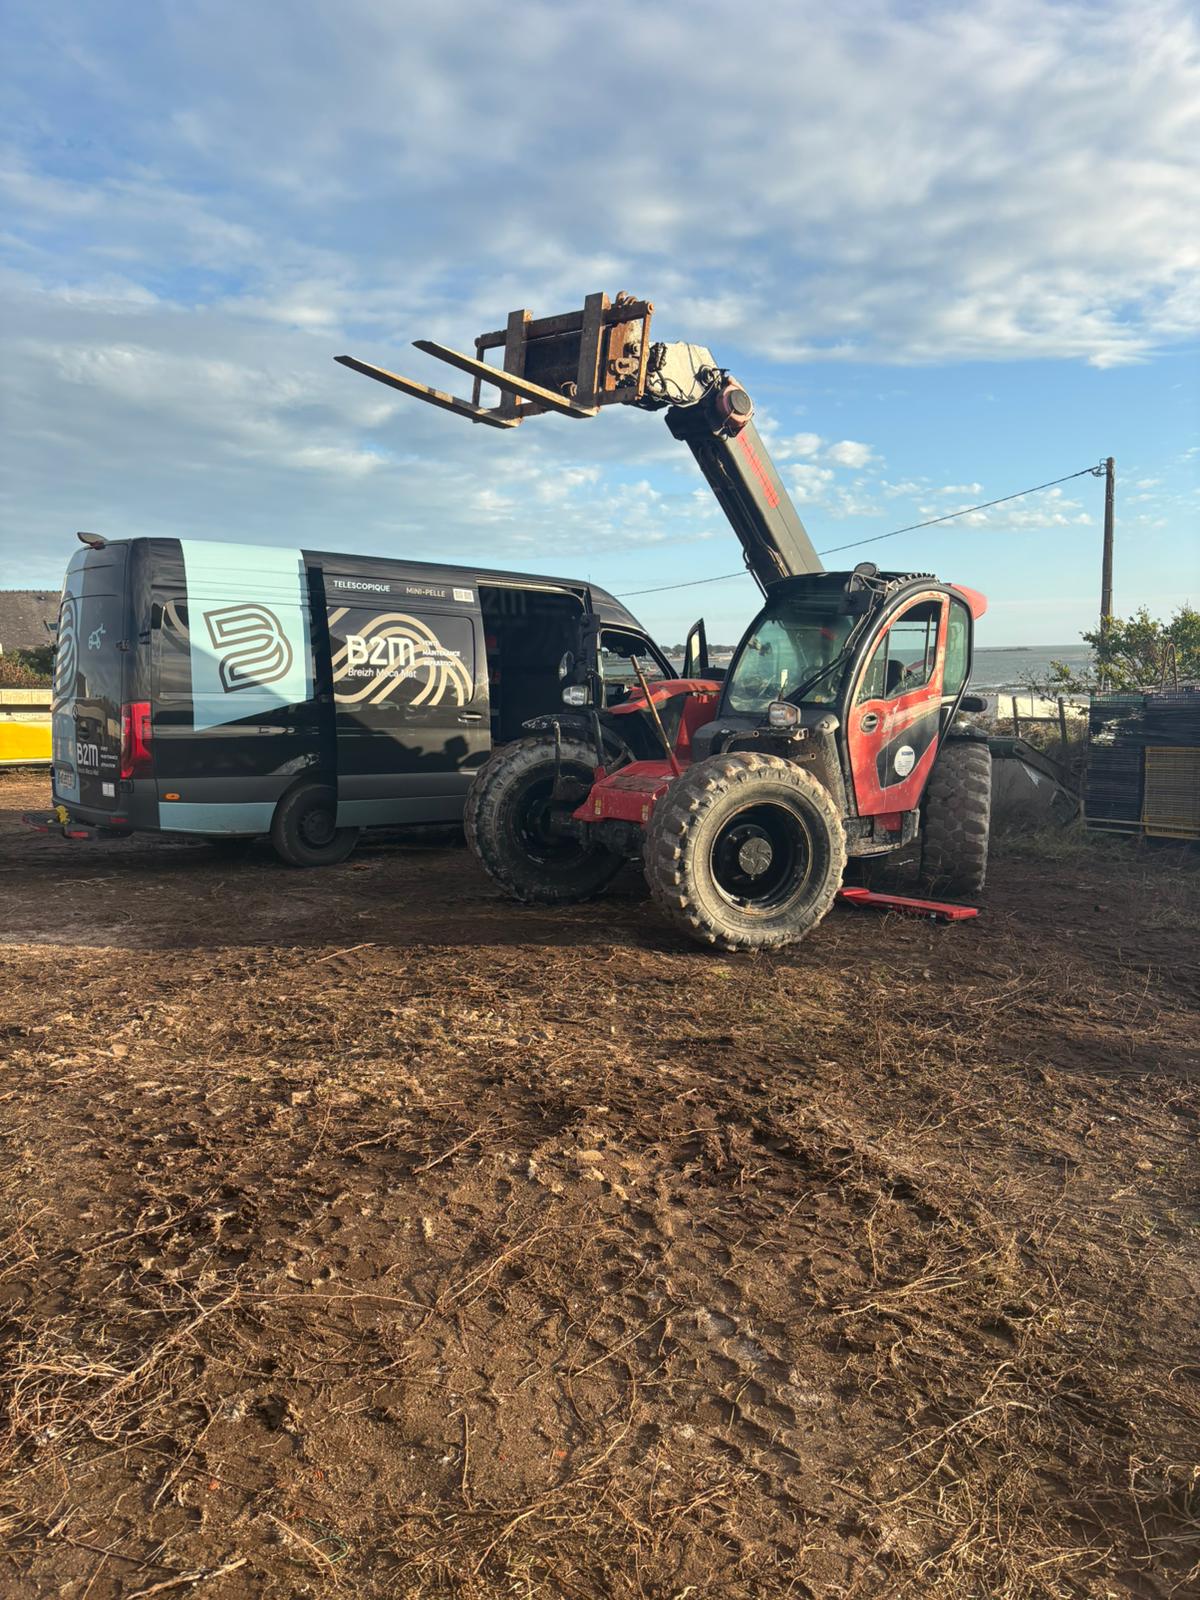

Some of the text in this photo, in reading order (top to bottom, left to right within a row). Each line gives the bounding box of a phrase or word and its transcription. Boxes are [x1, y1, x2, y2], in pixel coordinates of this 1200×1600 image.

[333, 580, 391, 592] TELESCOPIQUE
[345, 635, 417, 666] B2M
[348, 667, 374, 677] Breizh
[76, 742, 99, 767] B2M
